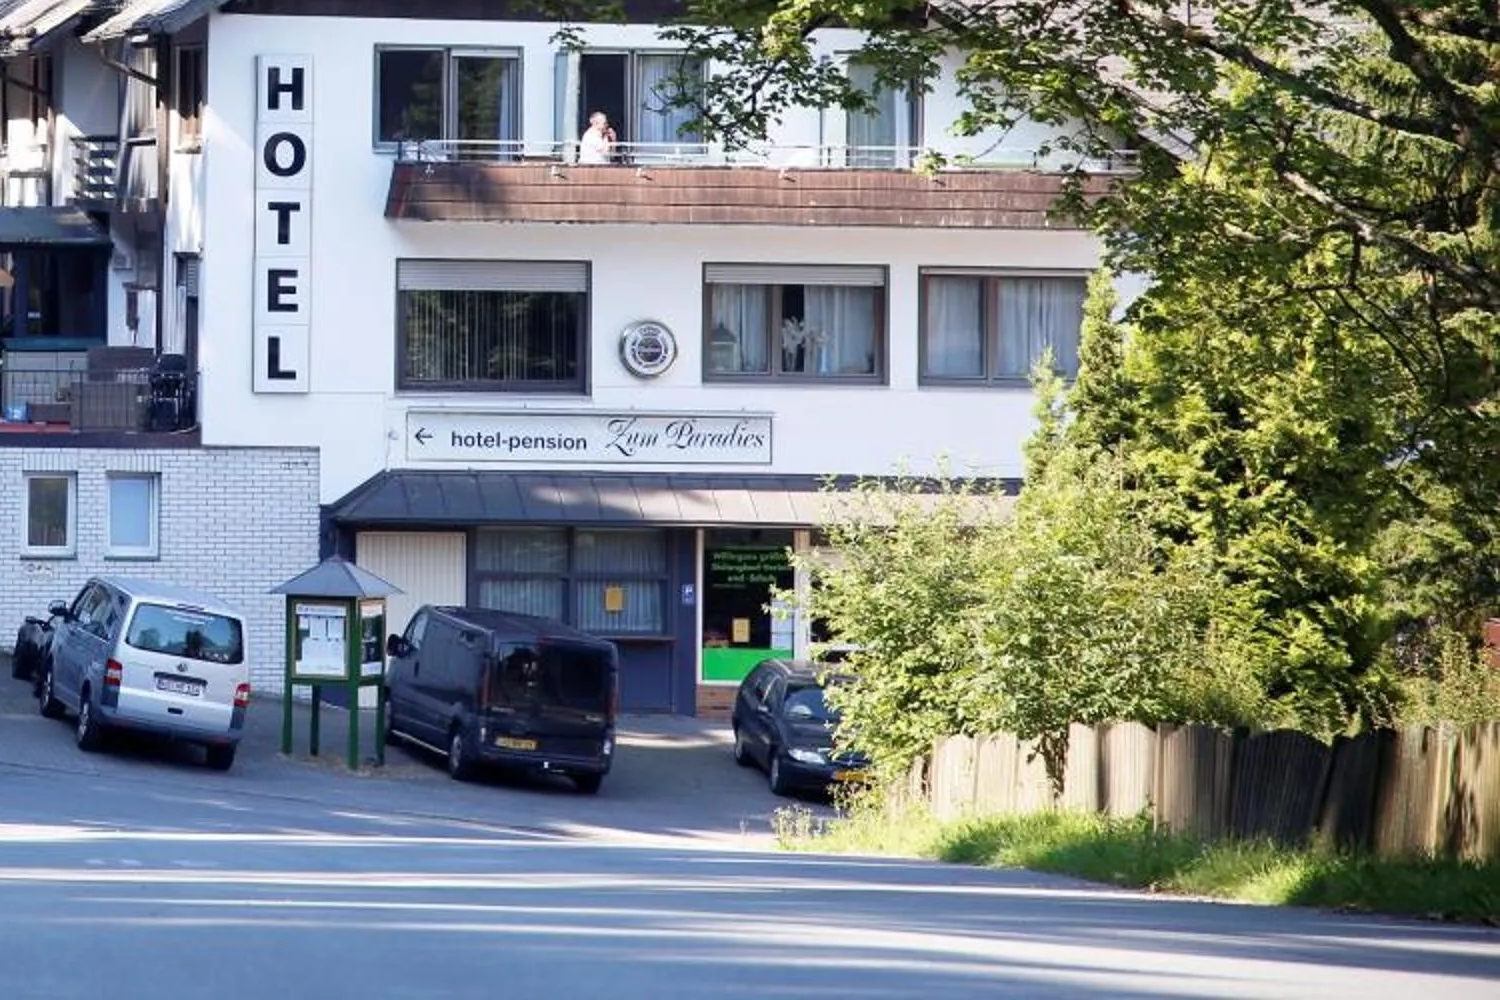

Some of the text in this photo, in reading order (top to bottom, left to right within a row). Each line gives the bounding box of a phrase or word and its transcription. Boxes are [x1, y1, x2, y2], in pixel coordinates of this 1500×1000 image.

[263, 66, 306, 380] HOTEL
[451, 417, 765, 457] hotel-pension Zum Paradies
